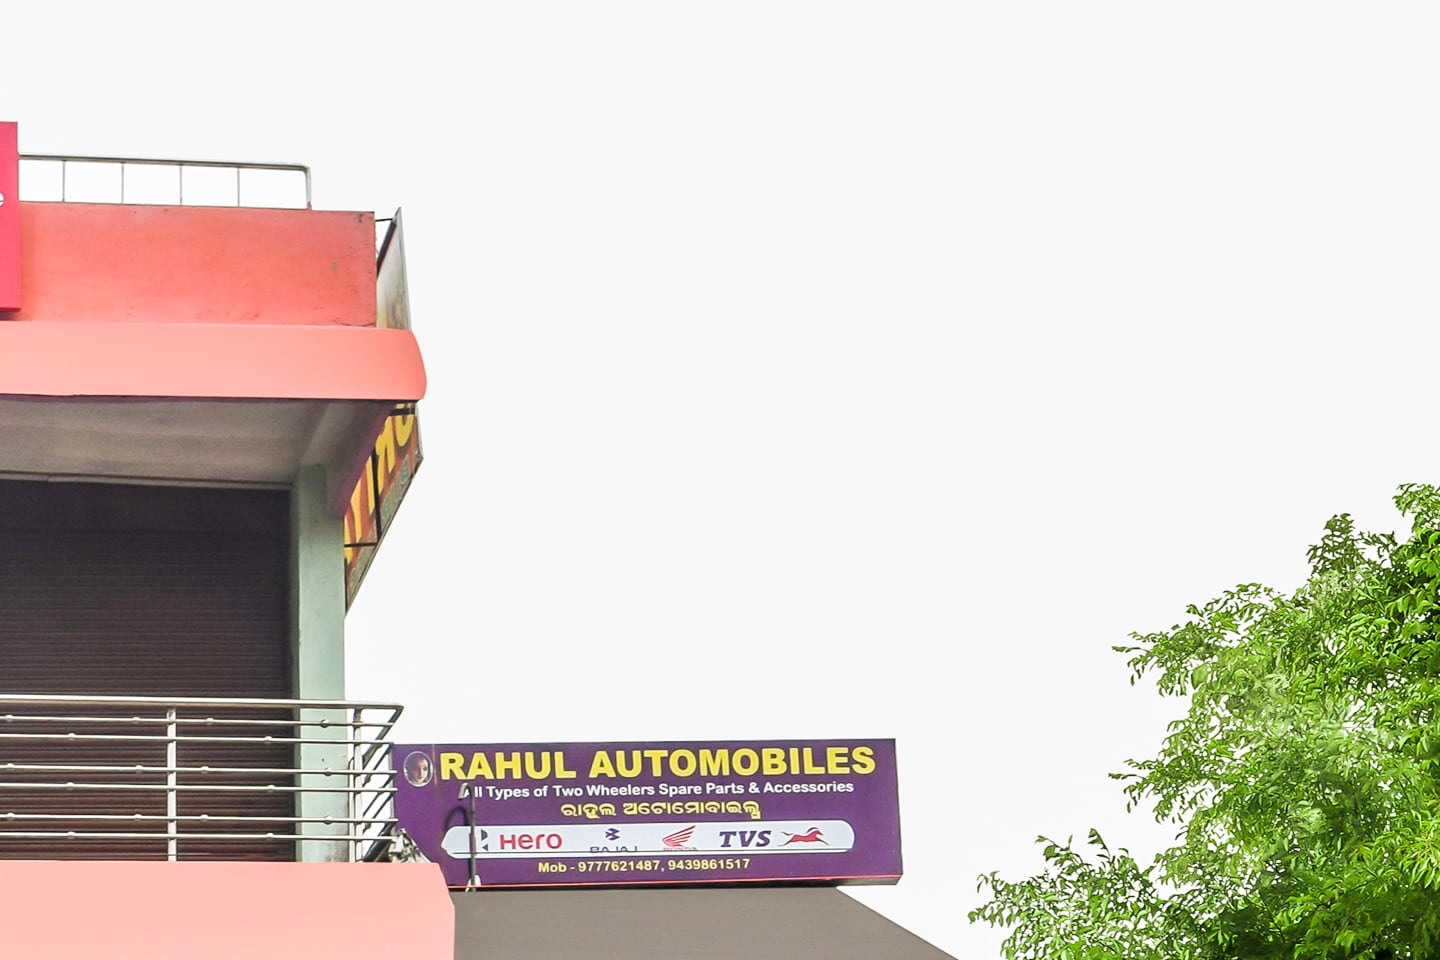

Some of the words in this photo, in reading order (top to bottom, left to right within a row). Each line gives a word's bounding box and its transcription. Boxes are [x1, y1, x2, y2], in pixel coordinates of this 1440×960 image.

[440, 751, 576, 781] RAHUL
[589, 747, 877, 779] AUTOMOBILES
[487, 785, 530, 801] Types
[533, 785, 549, 798] of
[553, 785, 583, 797] Two
[586, 784, 656, 797] Wheelers
[658, 783, 703, 798] Spare
[706, 783, 745, 796] Parts
[748, 782, 761, 794] &
[763, 781, 855, 794] Accessories
[499, 833, 563, 850] Hero
[719, 830, 772, 848] TVS
[538, 861, 567, 873] Mob
[578, 860, 665, 874] 9777621487,
[668, 858, 751, 871] 9439861517
